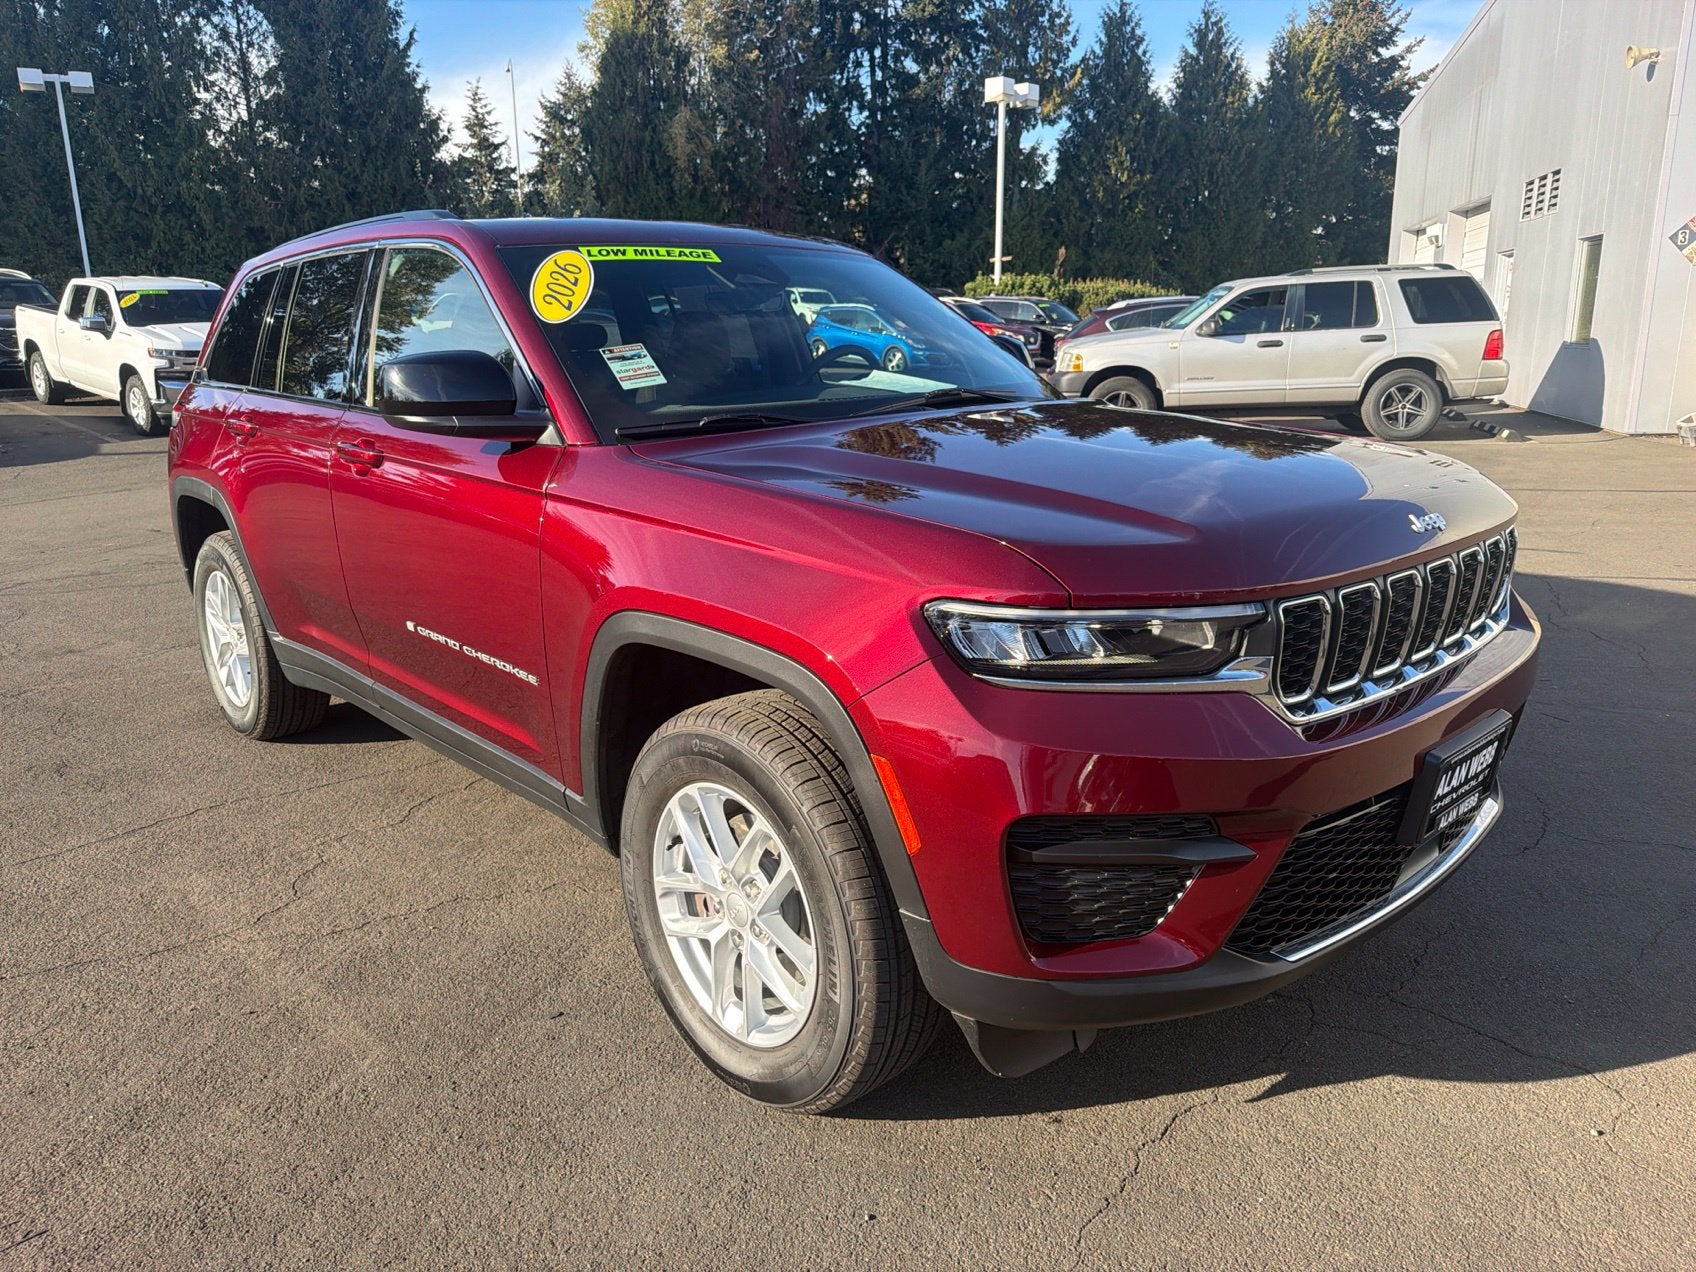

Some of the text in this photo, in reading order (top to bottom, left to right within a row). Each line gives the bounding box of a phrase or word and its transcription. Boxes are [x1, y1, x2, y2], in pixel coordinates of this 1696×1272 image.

[586, 248, 713, 260] LOW MILEAGE
[1679, 231, 1687, 244] 3
[543, 258, 583, 312] 2026
[1408, 512, 1446, 533] Jeep
[416, 626, 539, 686] GRAND CHEROKEE
[1433, 759, 1471, 801] ALAN
[1467, 740, 1499, 779] WEBB
[1429, 767, 1491, 814] CHEVROLET
[1437, 806, 1459, 831] ALAN
